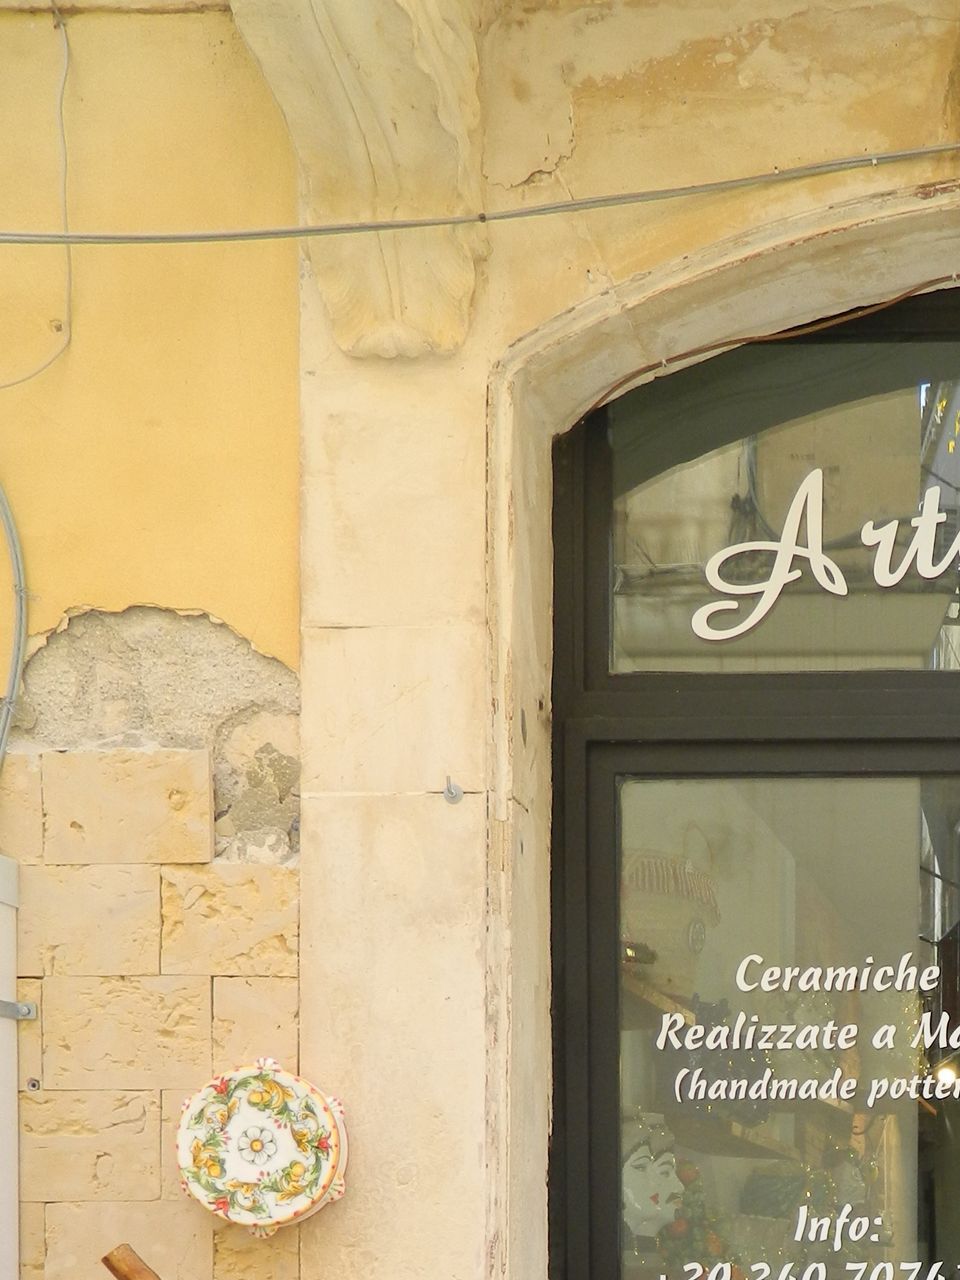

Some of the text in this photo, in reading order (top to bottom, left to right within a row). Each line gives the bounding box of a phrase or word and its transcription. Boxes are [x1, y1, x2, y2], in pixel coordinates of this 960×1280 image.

[735, 952, 940, 992] Ceramiche
[656, 1012, 858, 1050] Realizzate
[872, 1024, 897, 1050] a
[674, 1067, 857, 1102] (handmade
[794, 1203, 882, 1252] Info:
